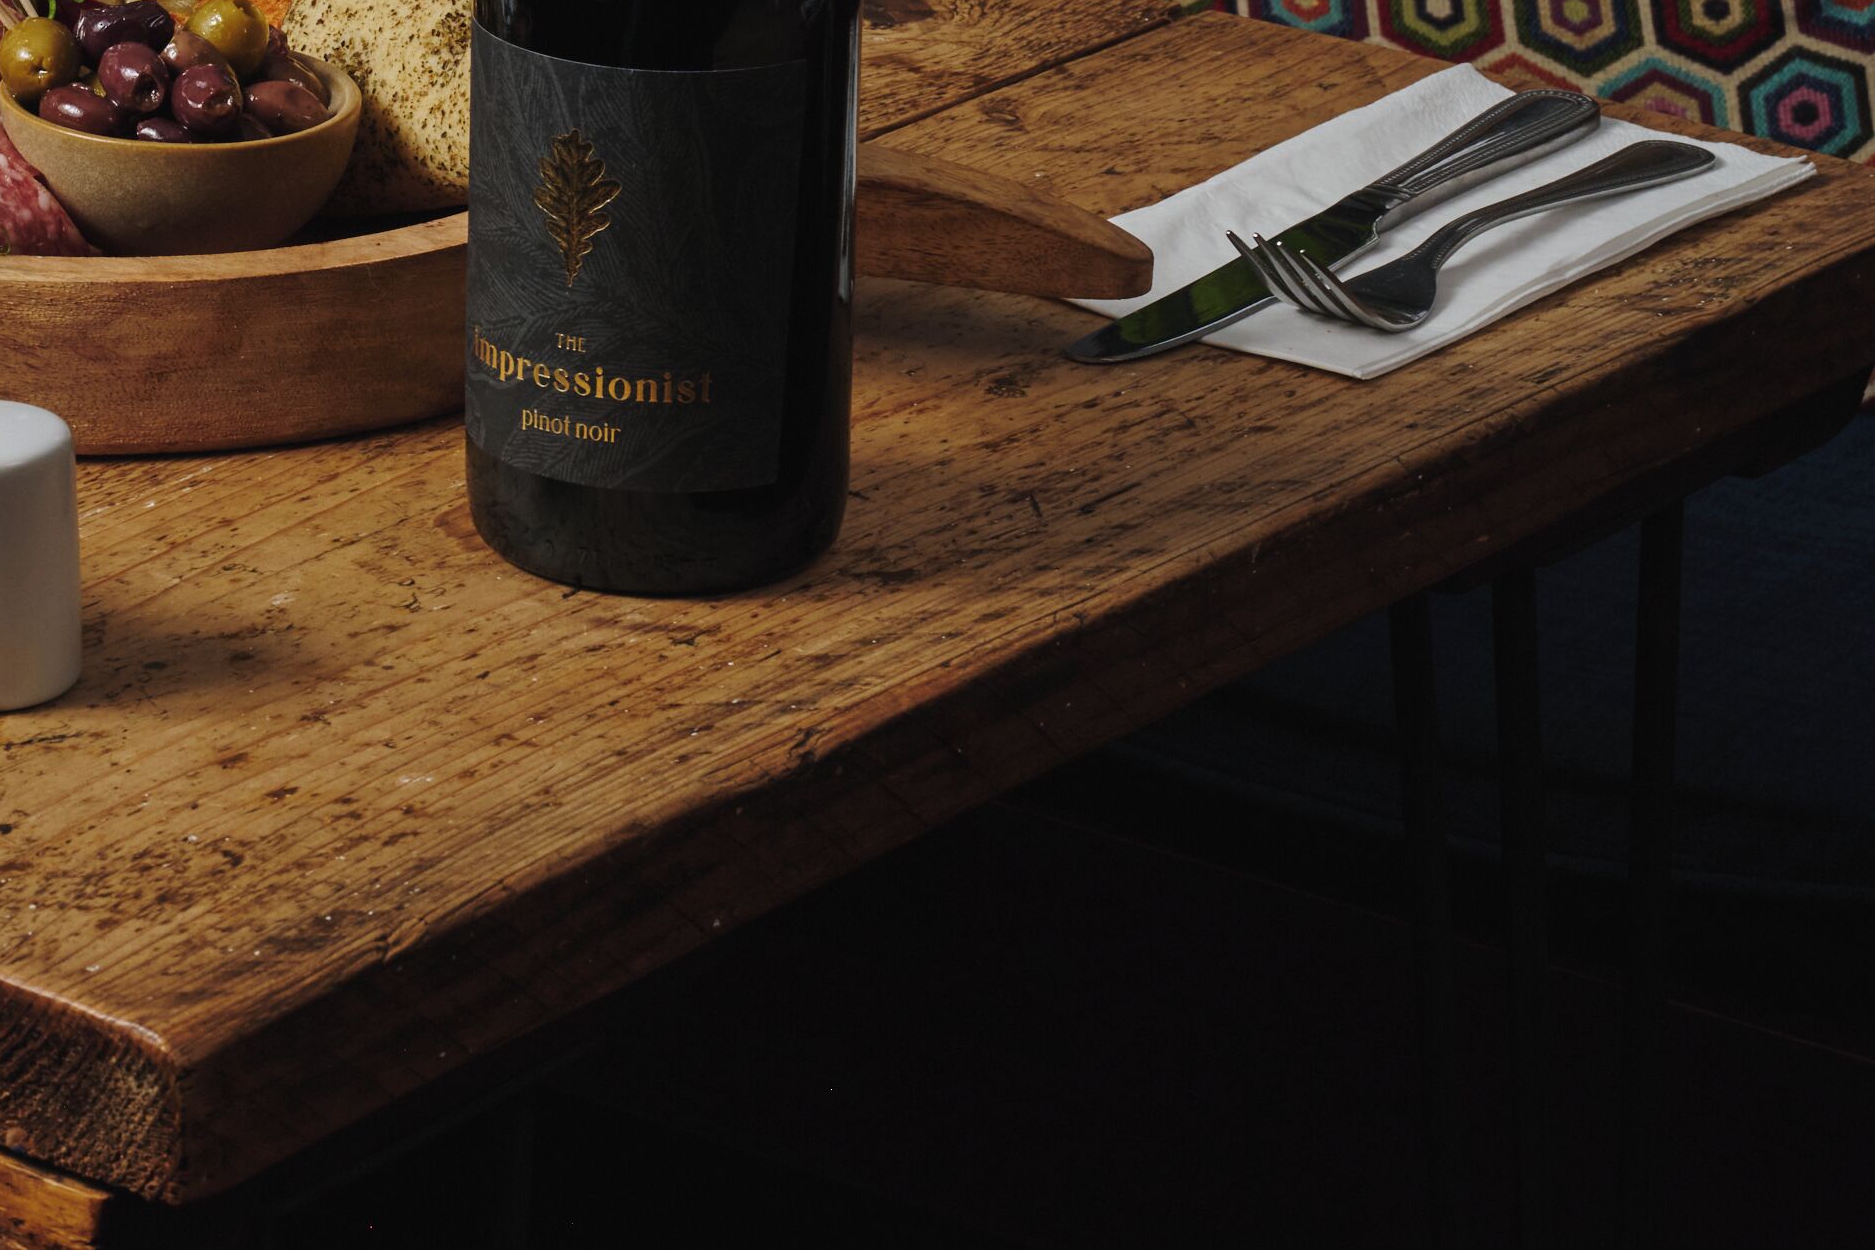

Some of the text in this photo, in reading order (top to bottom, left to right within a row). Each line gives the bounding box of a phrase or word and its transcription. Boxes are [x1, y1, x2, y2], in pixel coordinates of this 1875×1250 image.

[555, 332, 586, 353] THE
[473, 325, 713, 403] impressionist
[522, 408, 621, 444] pinot noir
